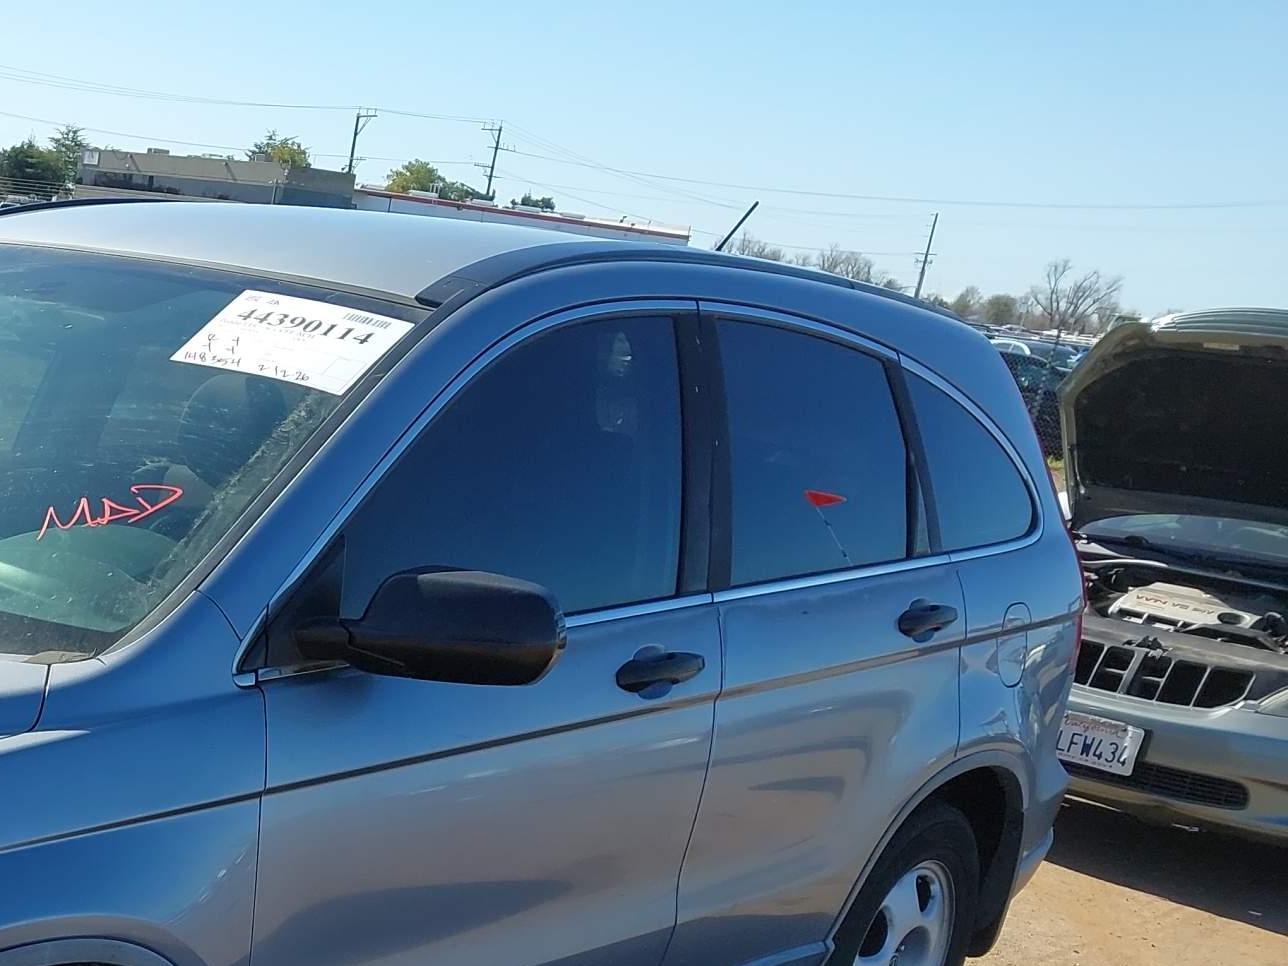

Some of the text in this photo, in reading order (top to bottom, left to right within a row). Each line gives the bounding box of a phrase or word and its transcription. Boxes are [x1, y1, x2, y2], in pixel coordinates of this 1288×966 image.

[237, 307, 375, 345] 44390114
[36, 484, 184, 541] MAD
[1056, 729, 1128, 767] LFW434
